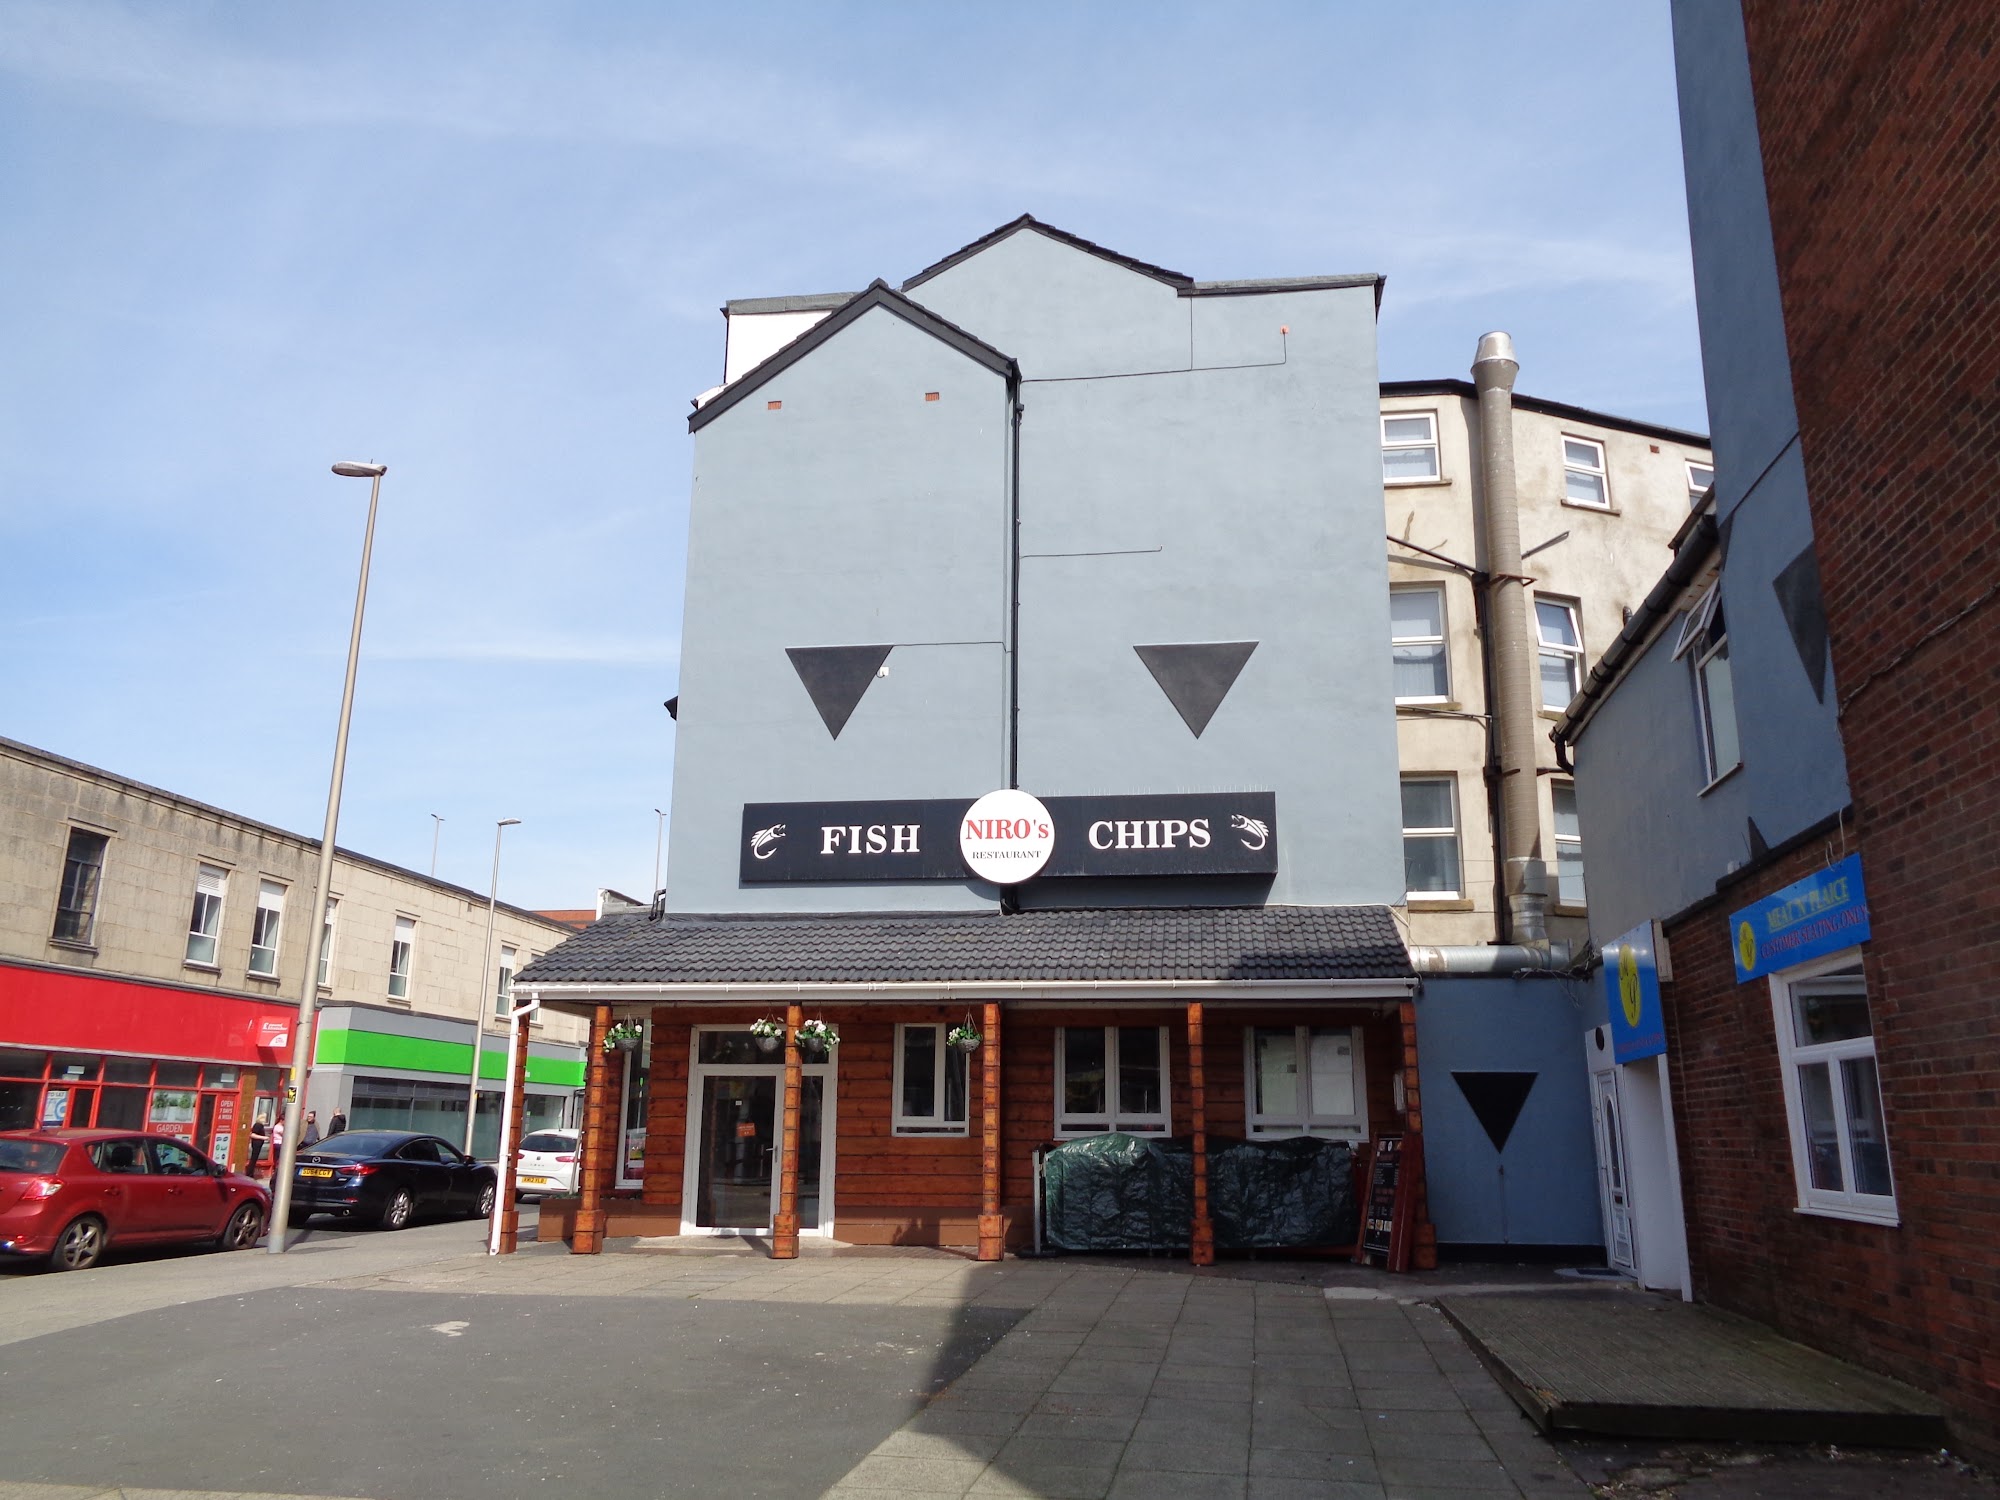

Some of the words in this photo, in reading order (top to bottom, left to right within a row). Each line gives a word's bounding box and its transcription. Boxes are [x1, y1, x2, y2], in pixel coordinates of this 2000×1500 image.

[820, 824, 921, 854] FISH
[965, 818, 1050, 840] NIRO's
[1088, 818, 1212, 850] CHIPS
[972, 850, 1042, 859] RESTAURANT
[1766, 902, 1792, 928] MEAT
[1808, 876, 1849, 911] PLAICE
[1760, 930, 1801, 959] CUSTOMER
[1801, 914, 1839, 943] SEATING
[1839, 904, 1868, 928] ONLY
[156, 1123, 183, 1133] GARDEN
